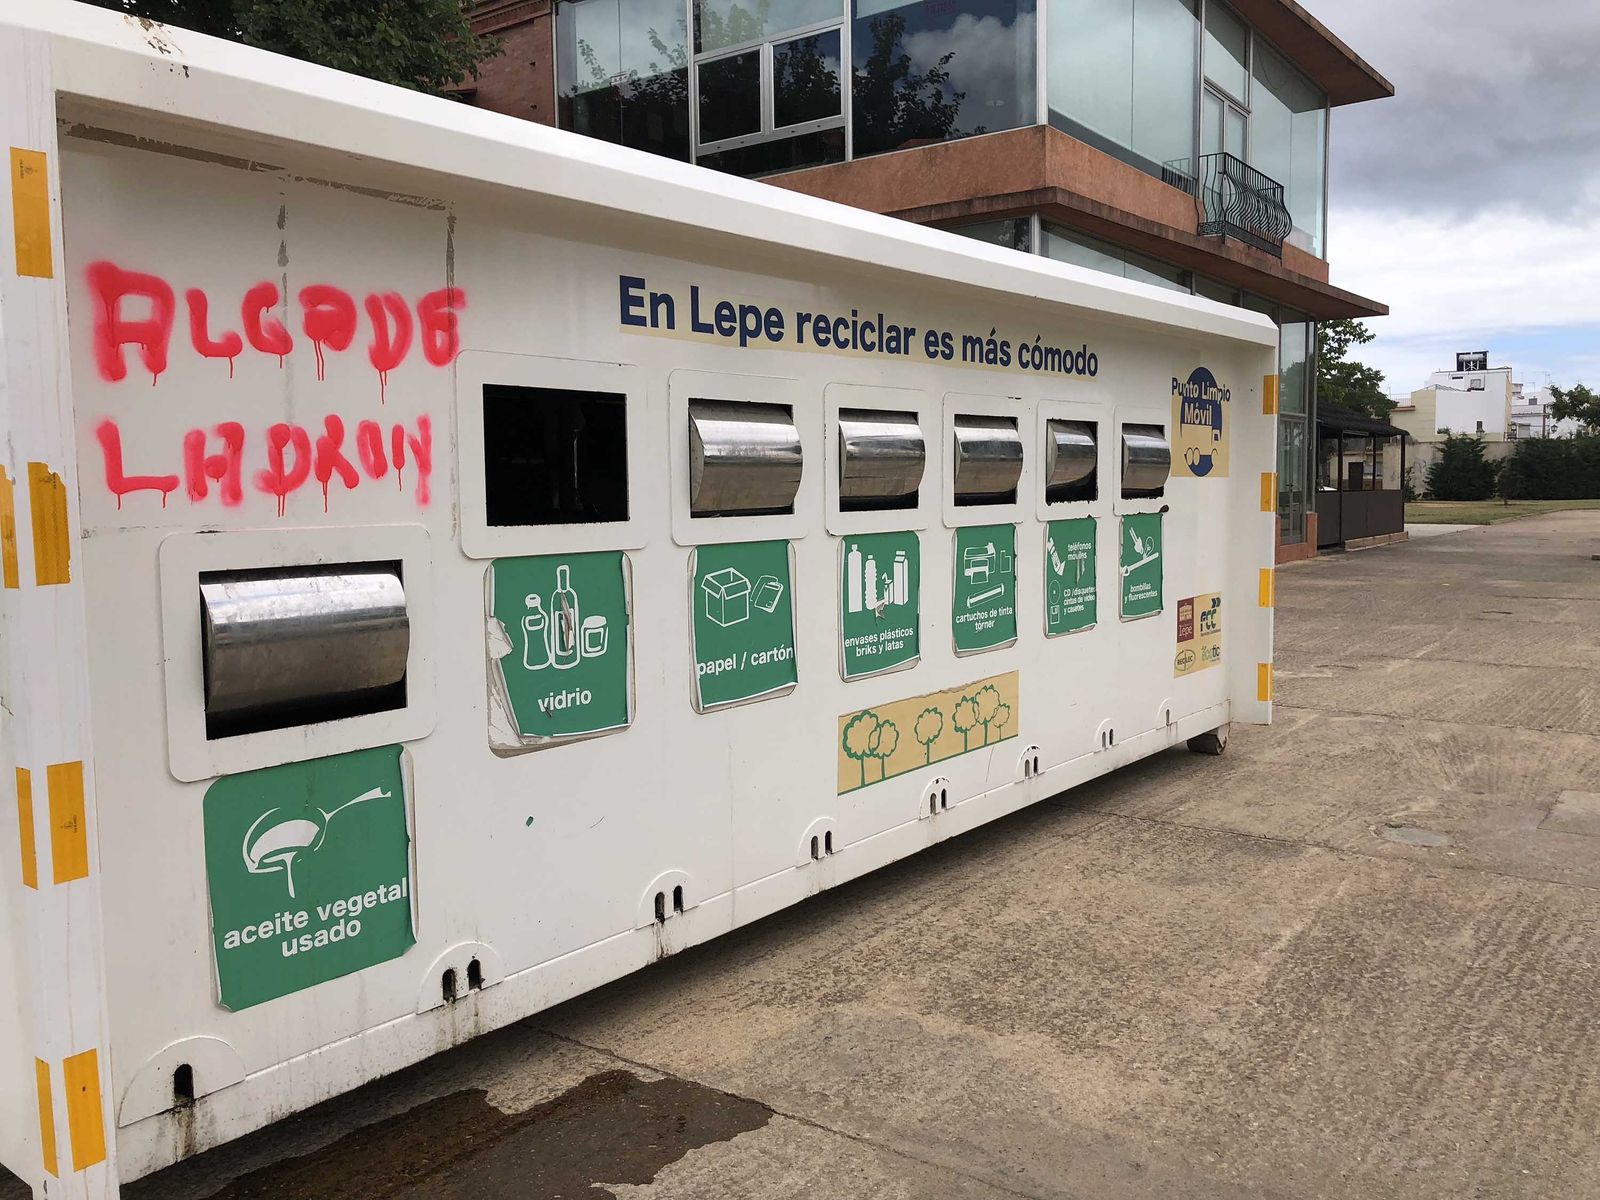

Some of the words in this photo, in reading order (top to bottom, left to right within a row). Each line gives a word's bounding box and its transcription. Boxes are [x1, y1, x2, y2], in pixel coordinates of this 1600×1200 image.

[619, 275, 676, 330] En
[690, 285, 785, 348] Lepe
[796, 309, 916, 356] reciclar
[924, 329, 954, 361] es
[961, 327, 1012, 368] más
[1017, 334, 1098, 377] cómodo
[1171, 377, 1199, 399] Punto
[1201, 381, 1231, 404] Limpio
[1184, 402, 1212, 425] Móvil
[1067, 541, 1092, 552] teléfonos
[1063, 588, 1071, 597] CD
[1124, 596, 1128, 604] y
[1128, 590, 1158, 601] fluorescentes
[1130, 582, 1151, 593] bombillas
[1077, 596, 1083, 604] de
[955, 611, 989, 624] cartuchos
[989, 608, 997, 618] de
[998, 606, 1013, 616] tinta
[845, 634, 878, 647] envases
[879, 626, 914, 643] plásticos
[855, 645, 877, 657] briks
[878, 645, 883, 655] y
[885, 639, 904, 651] latas
[697, 650, 737, 679] papel
[750, 644, 794, 667] cartón
[537, 687, 592, 713] vidrio
[223, 910, 309, 950] aceite
[316, 877, 407, 922] vegetal
[281, 918, 361, 958] usado
